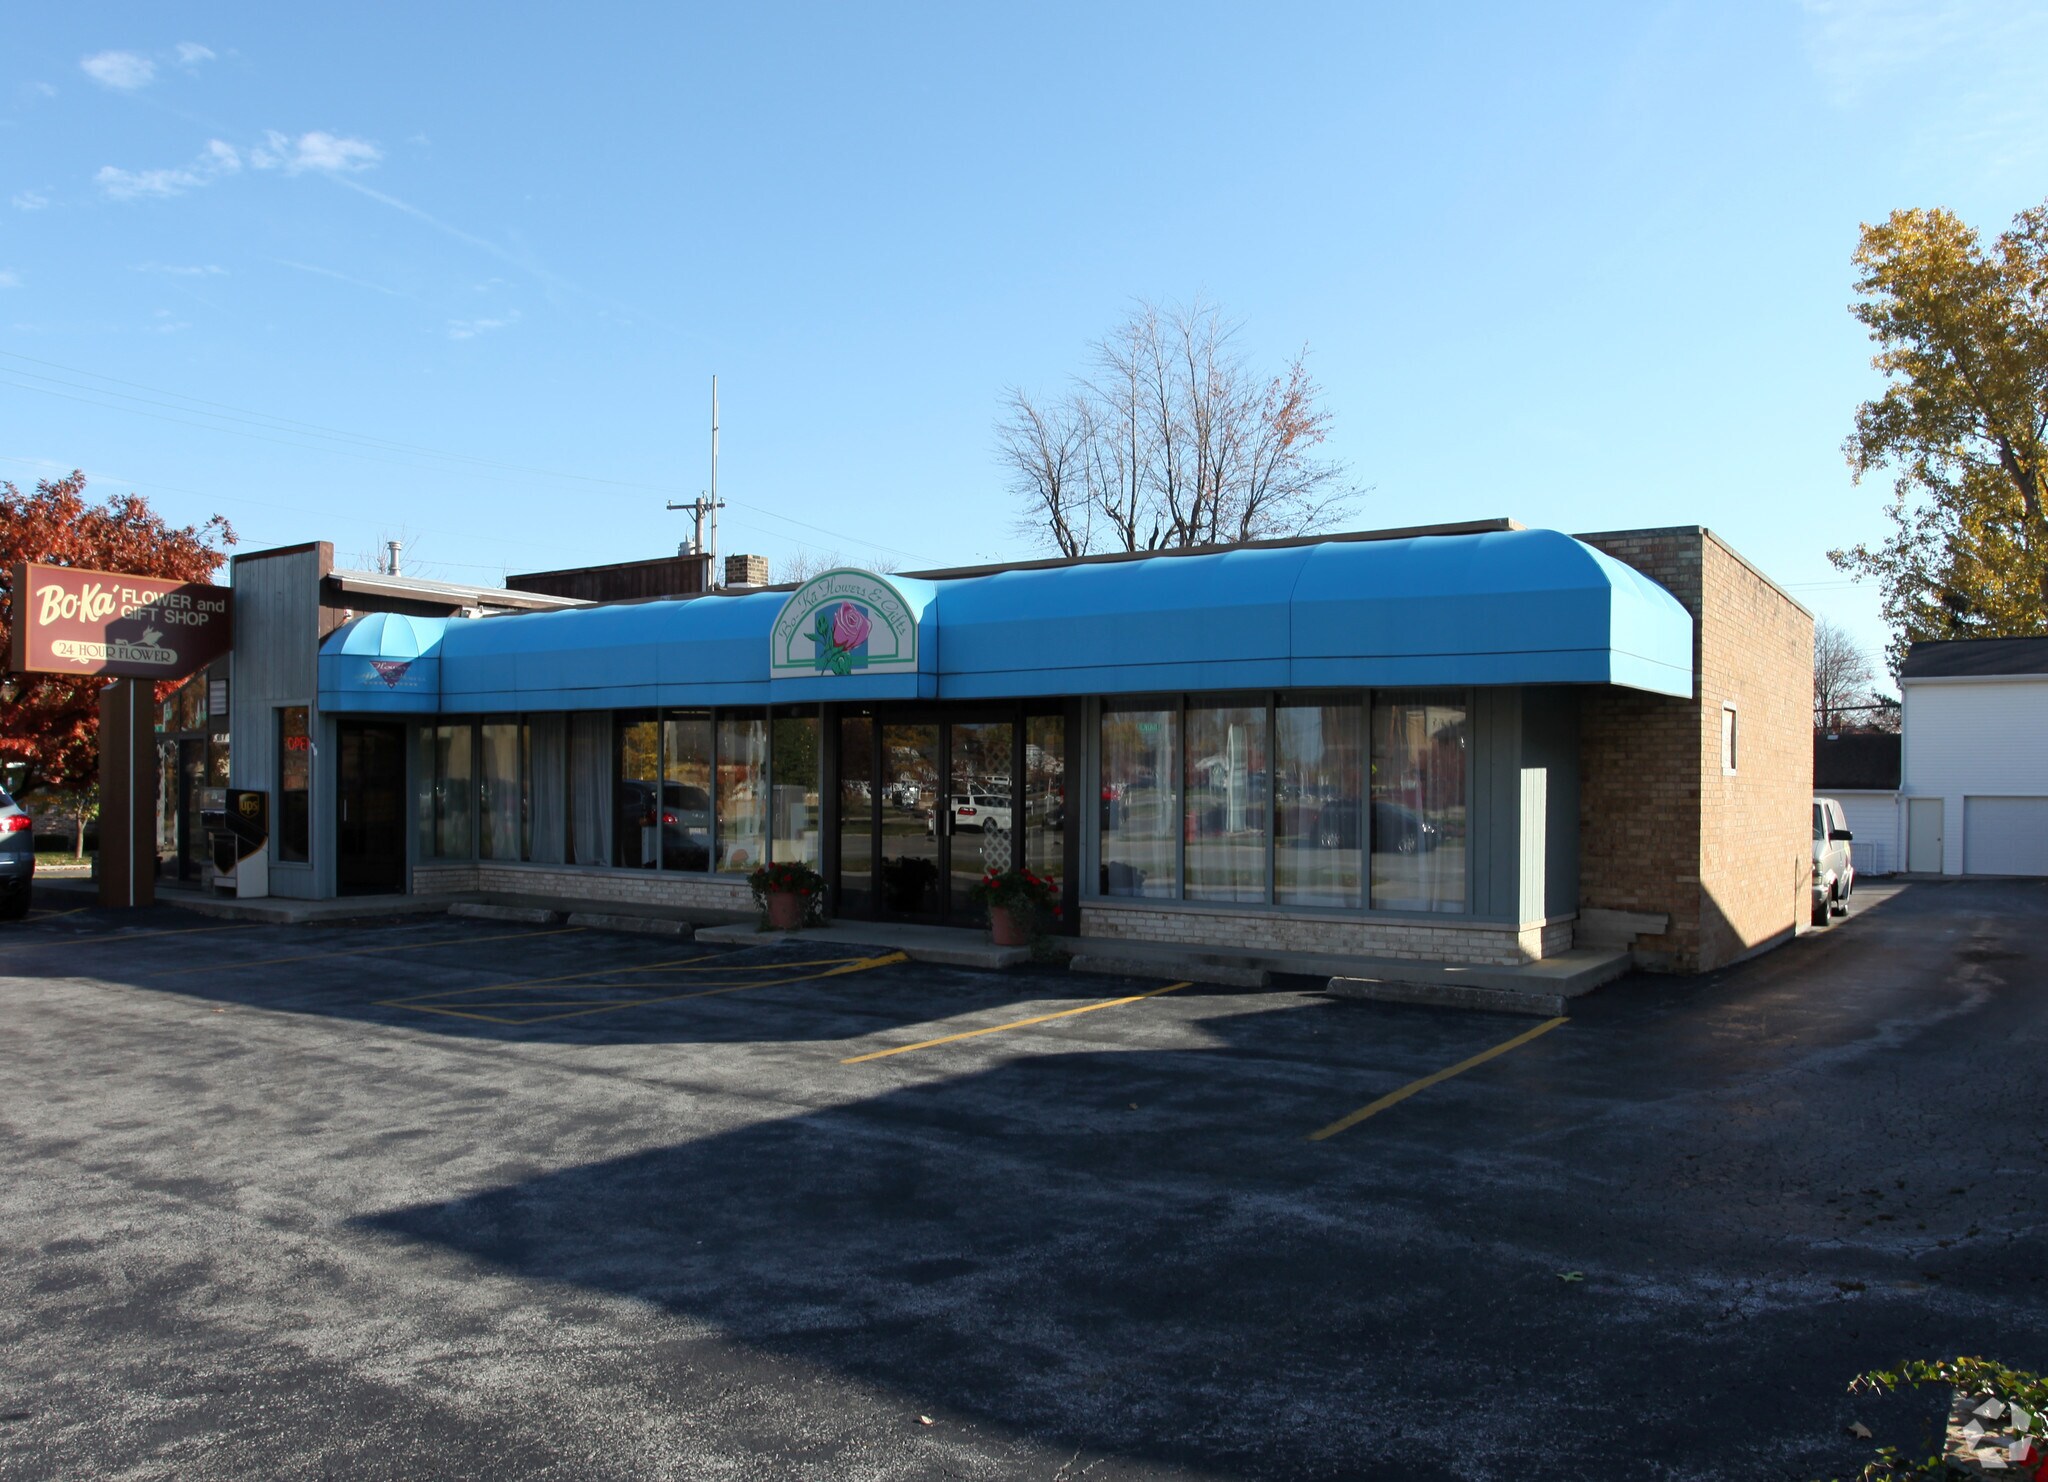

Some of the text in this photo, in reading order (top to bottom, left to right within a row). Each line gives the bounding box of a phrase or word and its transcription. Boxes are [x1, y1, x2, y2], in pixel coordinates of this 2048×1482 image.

[122, 588, 225, 613] FLOWER and
[818, 576, 866, 598] Flowers
[868, 588, 882, 602] &
[881, 600, 908, 636] Gifts
[120, 605, 209, 626] GIFT SHOP
[79, 644, 116, 657] HOUR
[119, 647, 171, 662] FLOWER
[287, 736, 309, 751] OPE
[241, 800, 258, 815] ups
